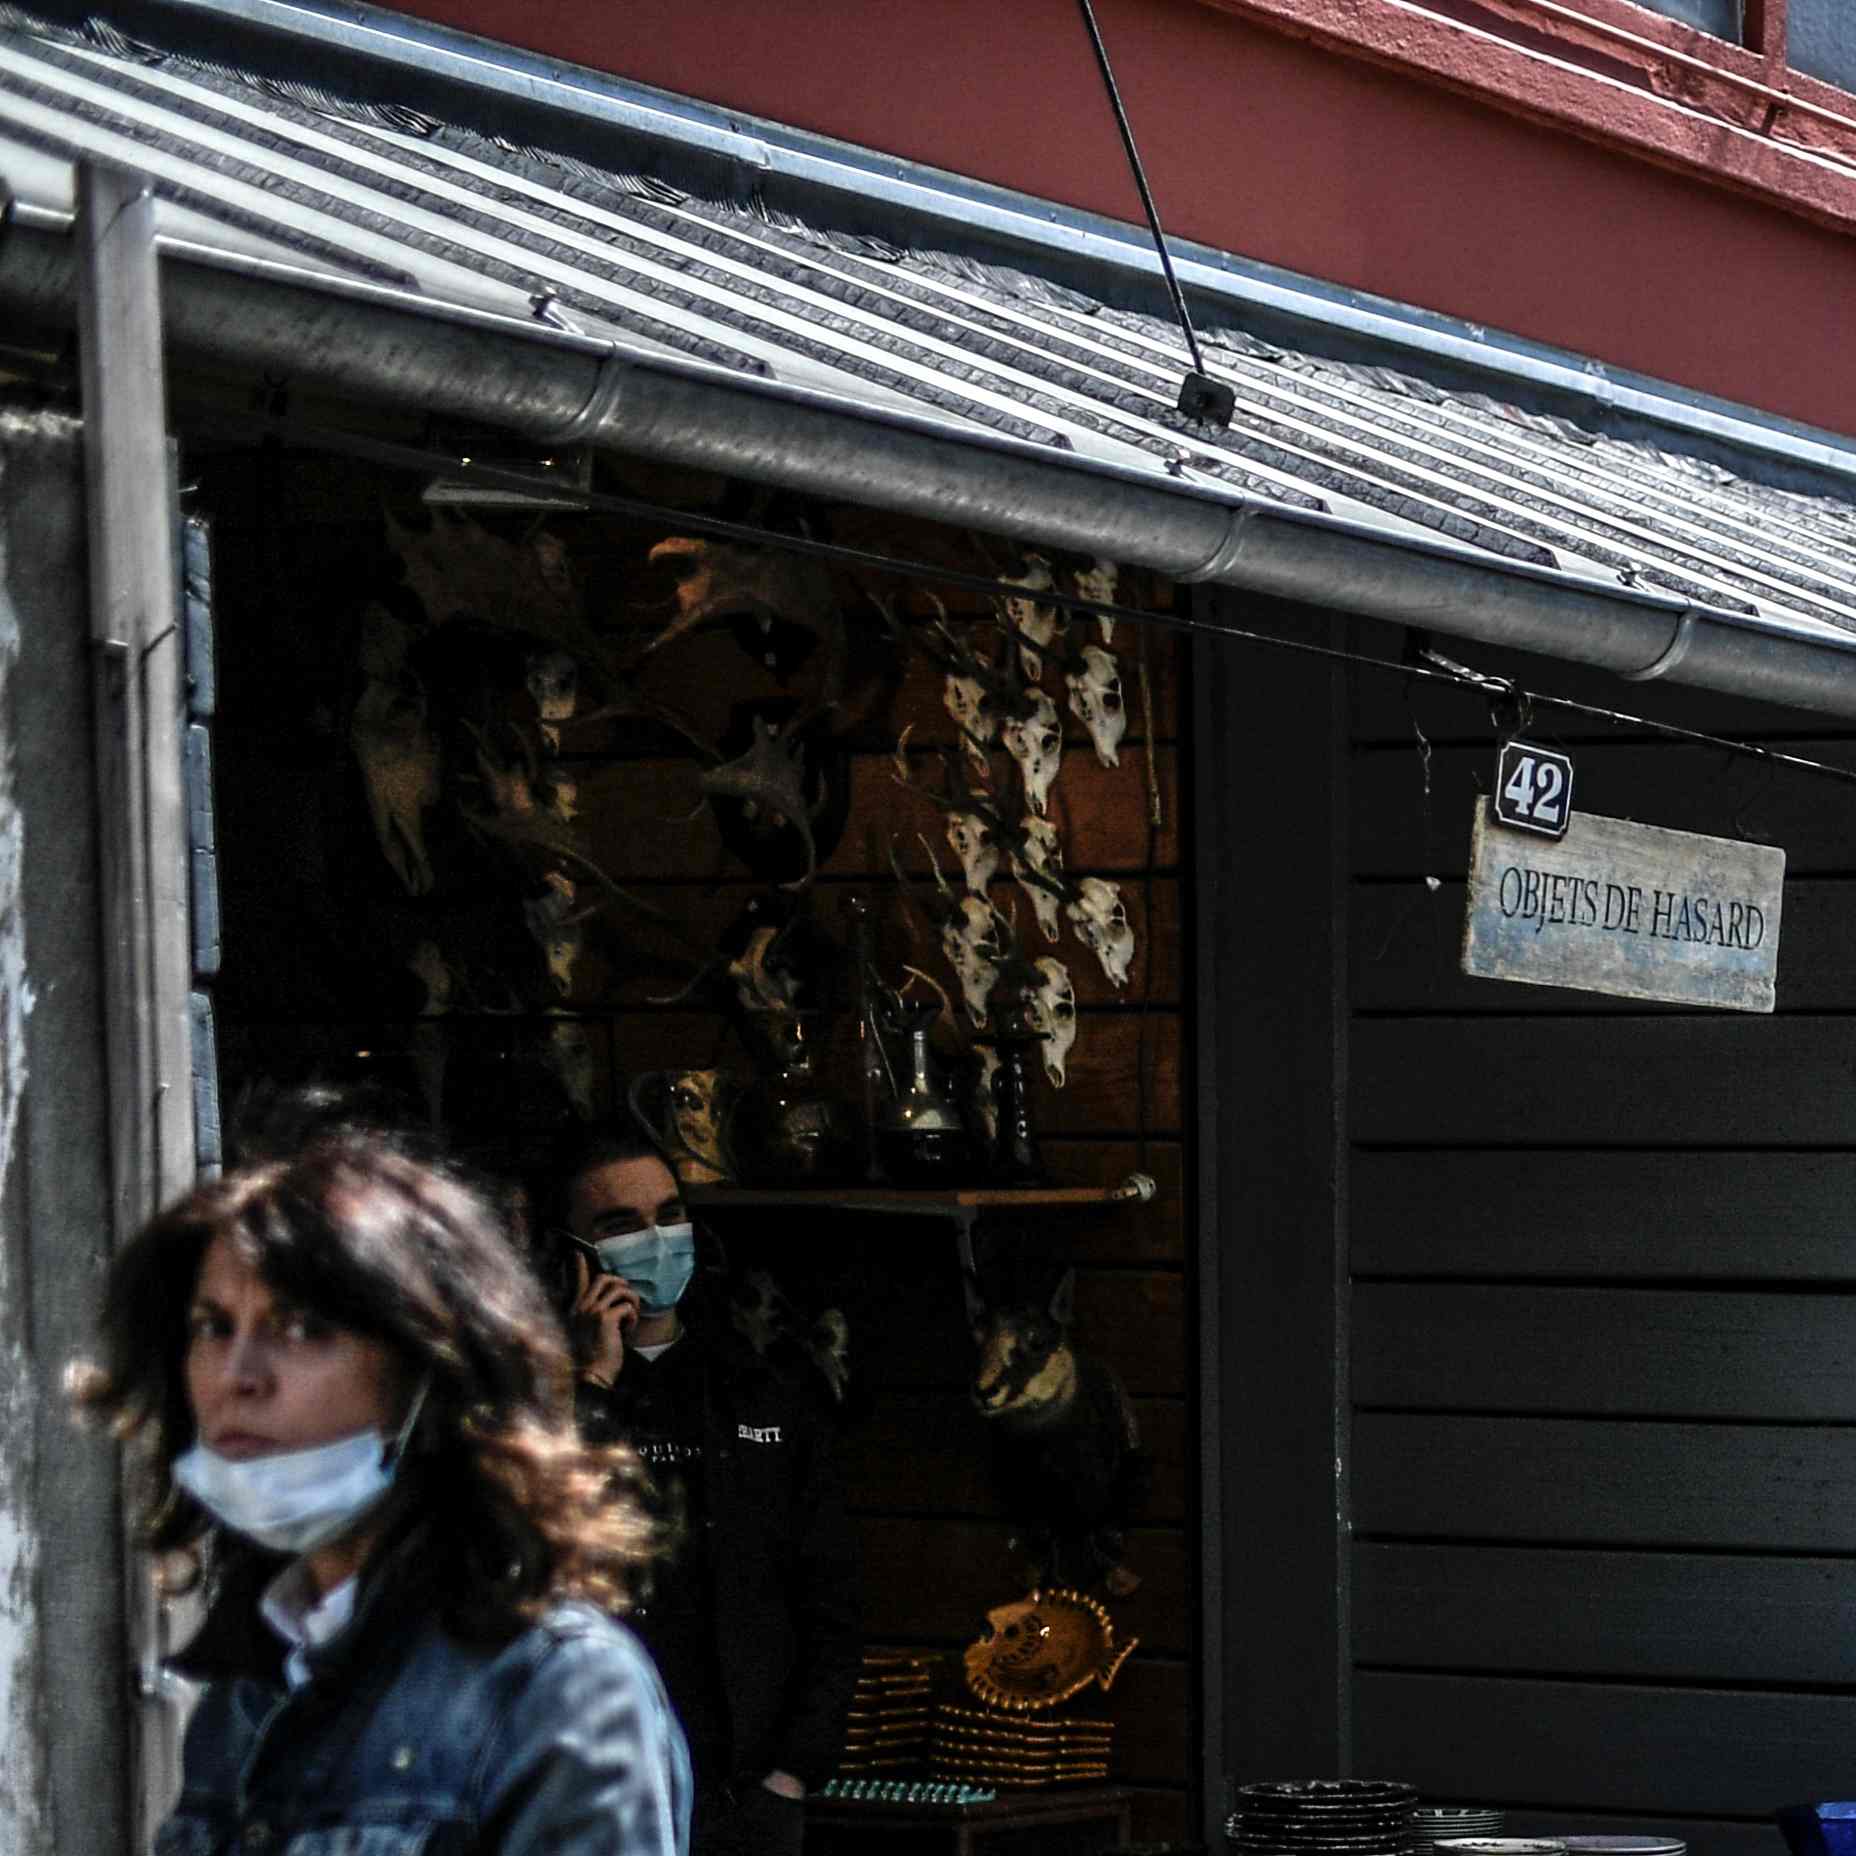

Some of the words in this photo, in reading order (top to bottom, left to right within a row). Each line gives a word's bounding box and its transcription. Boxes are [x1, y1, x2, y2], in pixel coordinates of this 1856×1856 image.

[1506, 757, 1563, 822] 42
[1500, 867, 1598, 933] OBJETS
[1603, 885, 1643, 934] DE
[1651, 890, 1765, 951] HASARD
